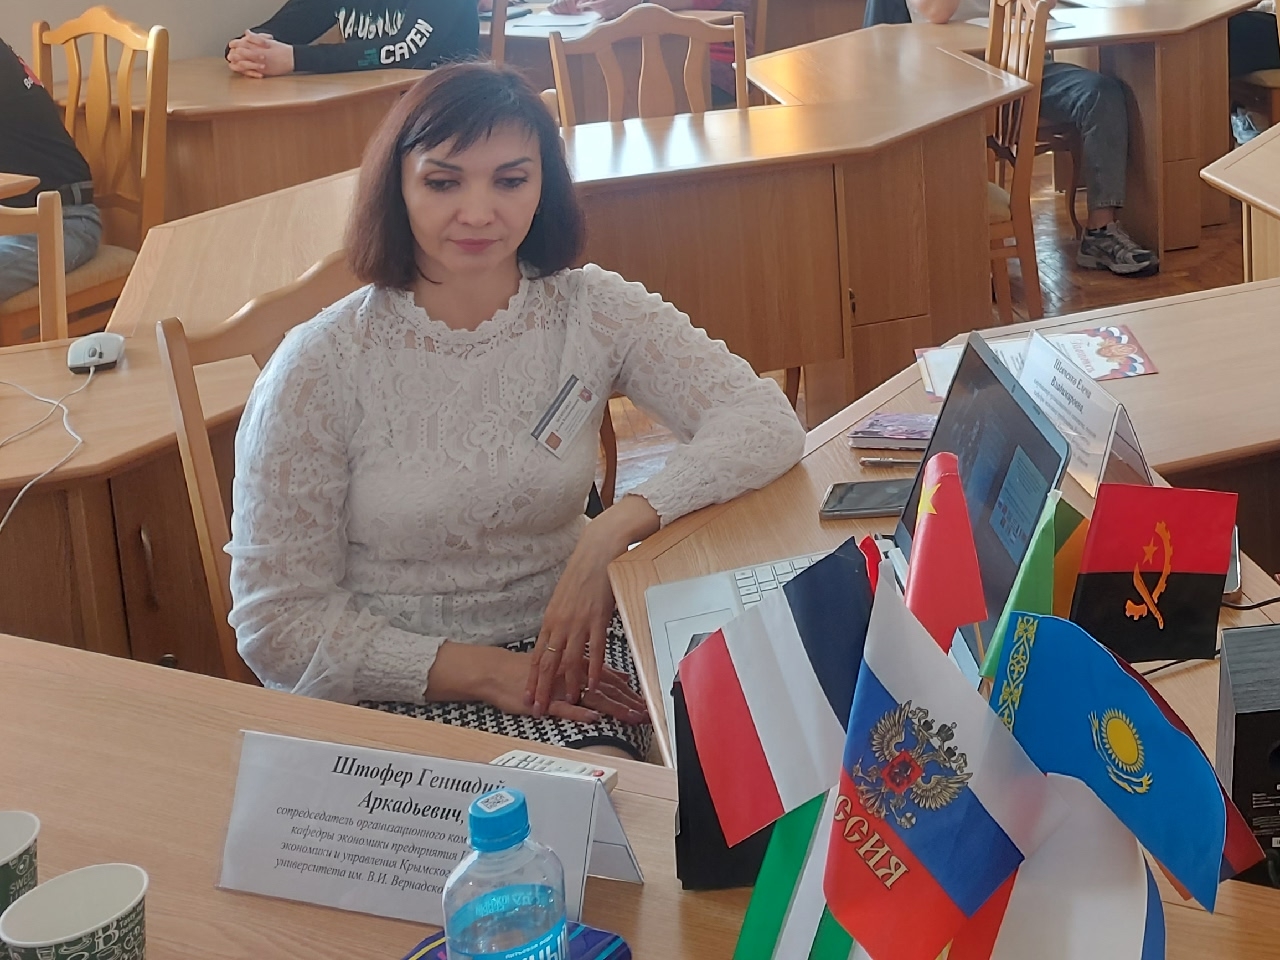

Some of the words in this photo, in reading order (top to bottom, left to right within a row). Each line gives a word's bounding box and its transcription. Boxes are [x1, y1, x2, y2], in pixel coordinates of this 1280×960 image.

[331, 755, 413, 789] Штофер
[276, 805, 354, 827] сопредседатель
[355, 818, 447, 842] организационного
[357, 790, 464, 825] Аркадьевич,
[280, 840, 333, 859] экономики
[341, 851, 398, 870] управления
[398, 858, 451, 878] Крымског
[290, 824, 335, 842] кафедры
[337, 833, 389, 850] экономики
[391, 841, 458, 861] предприятия
[834, 795, 910, 890] ССИЯ
[273, 857, 346, 879] университета
[347, 869, 364, 881] им.
[366, 870, 389, 886] В.И.
[390, 874, 445, 895] Вернадско
